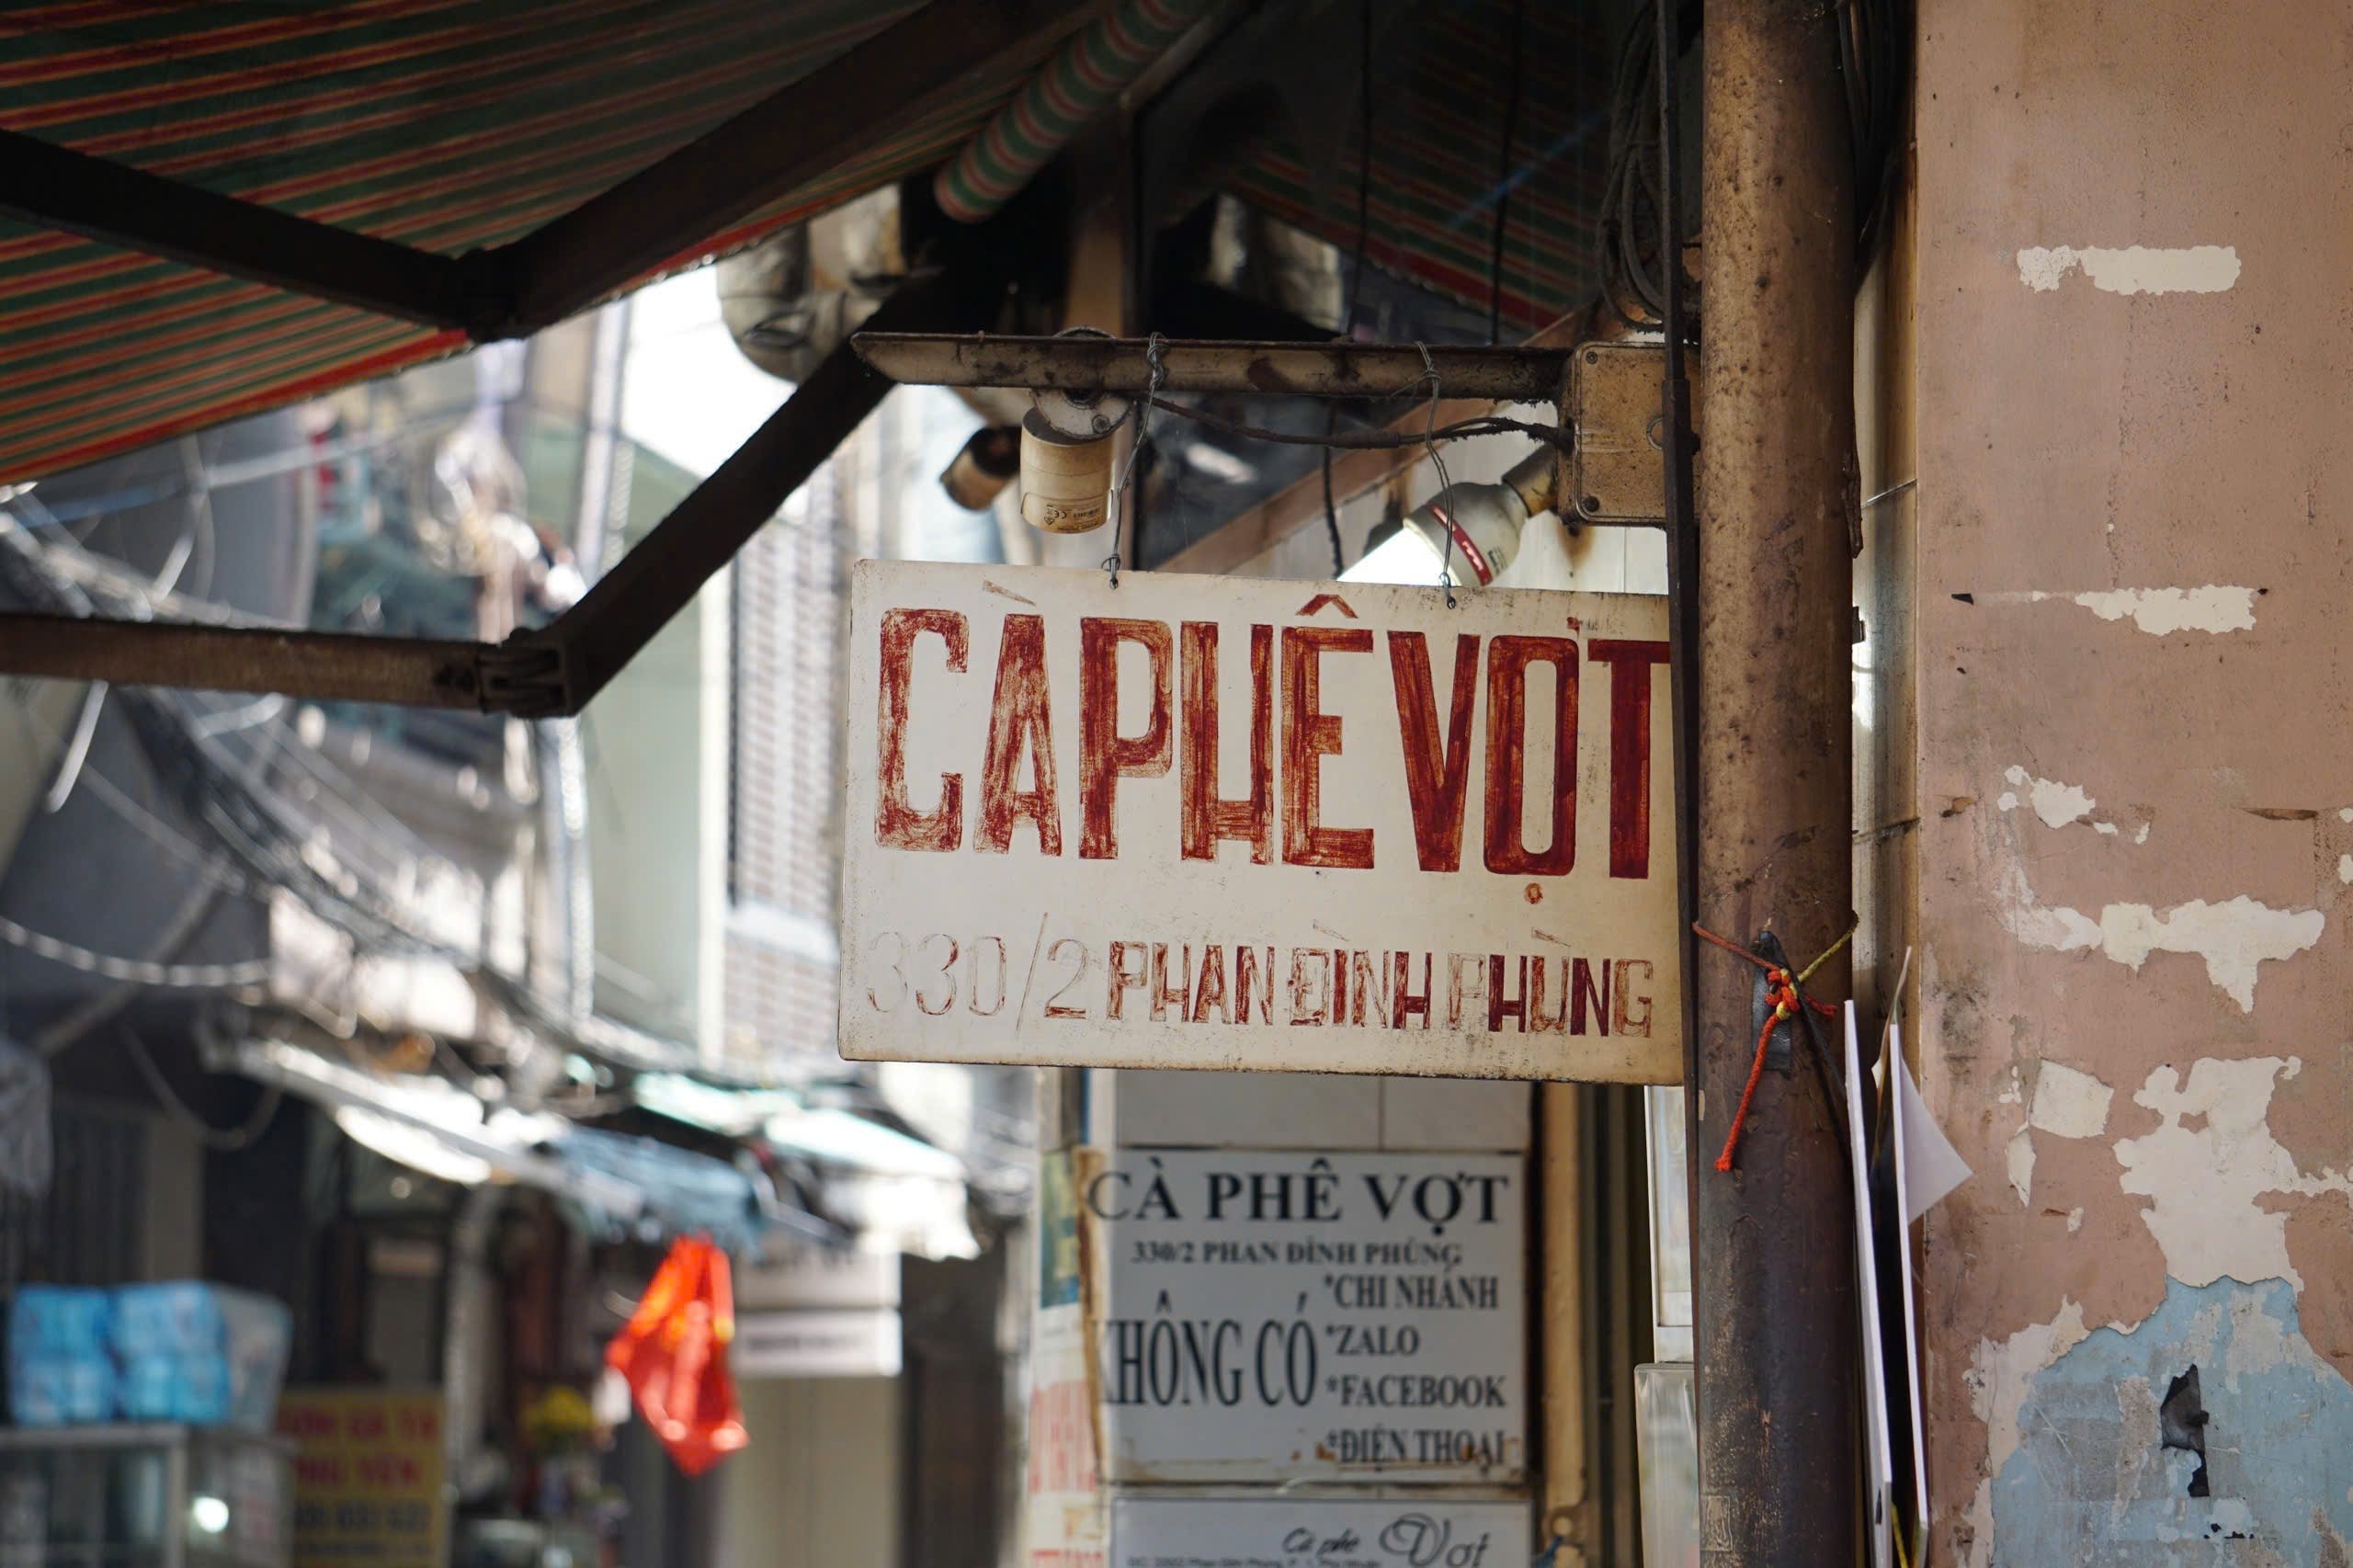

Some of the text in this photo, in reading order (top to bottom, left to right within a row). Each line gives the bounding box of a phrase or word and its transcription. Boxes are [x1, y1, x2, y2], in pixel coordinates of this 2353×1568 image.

[874, 579, 1669, 905] CÀ PHÊ VỢT
[867, 913, 1654, 1039] 330/2 PHAN ĐÌNH PHÙNG
[1087, 1155, 1509, 1236] CÀ PHÊ VỢT
[1203, 1241, 1279, 1264] PHAN
[1255, 1290, 1318, 1406] CÓ
